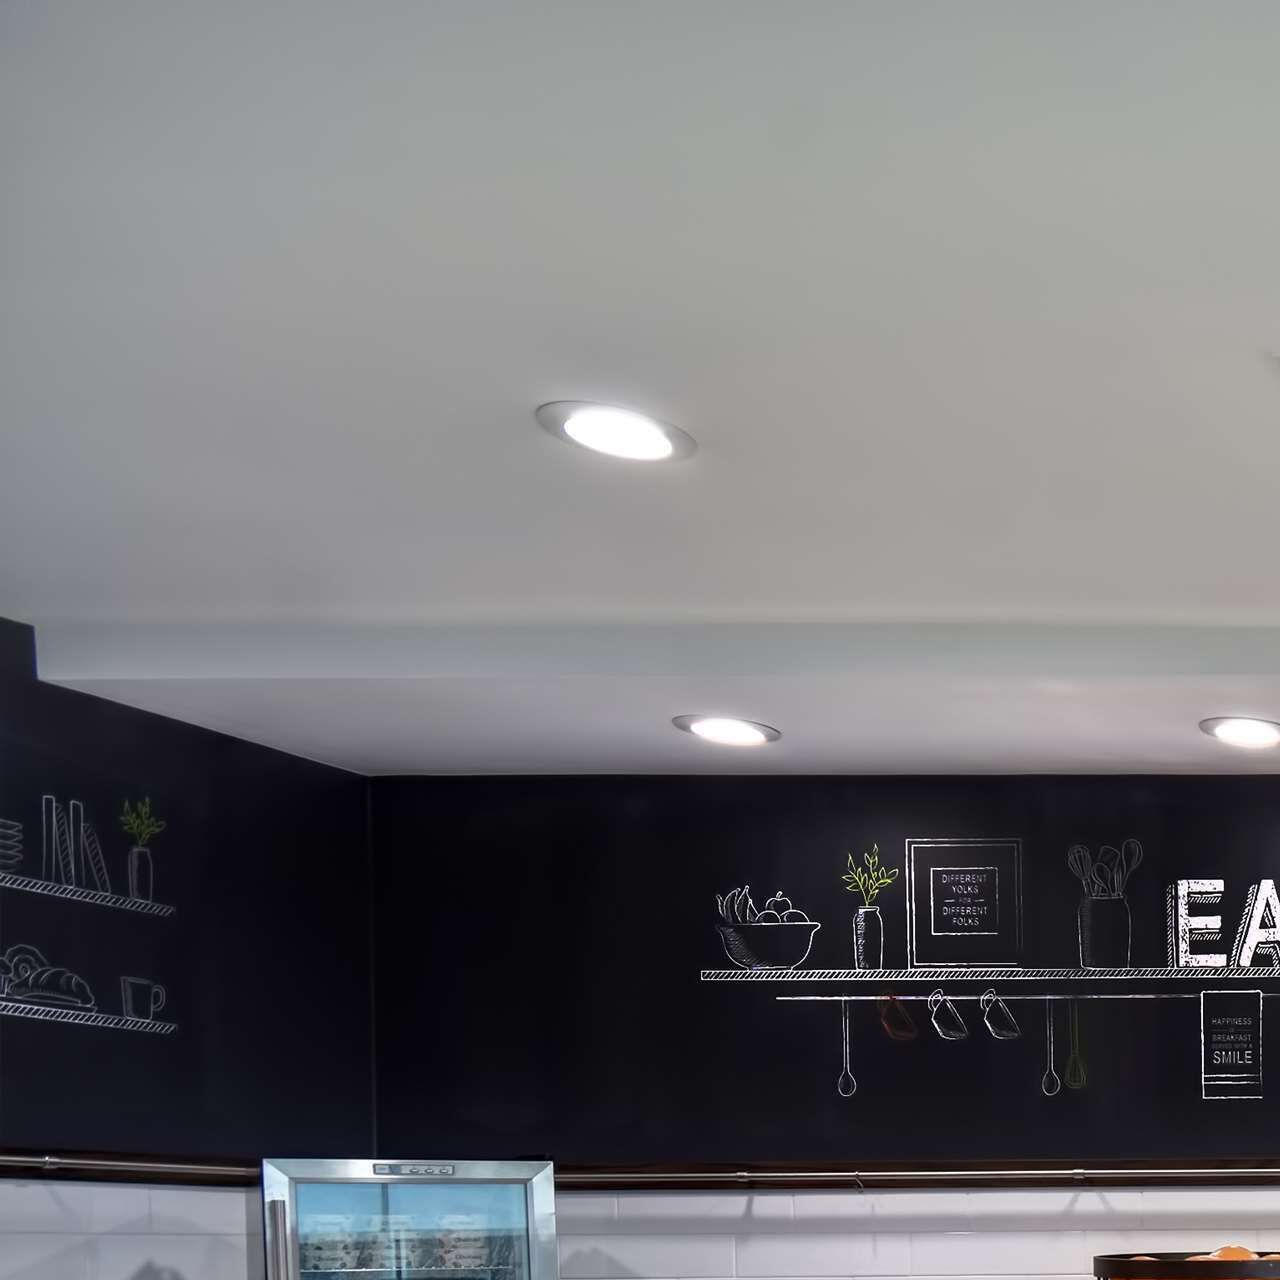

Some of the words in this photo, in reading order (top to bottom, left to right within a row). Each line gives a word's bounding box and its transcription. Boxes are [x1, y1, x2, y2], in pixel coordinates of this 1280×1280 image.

[942, 874, 986, 883] DIFFERENT
[952, 885, 979, 893] YOLKS
[943, 906, 987, 915] DIFFERENT
[953, 917, 979, 926] FOLKS
[1212, 1050, 1253, 1064] SMILE
